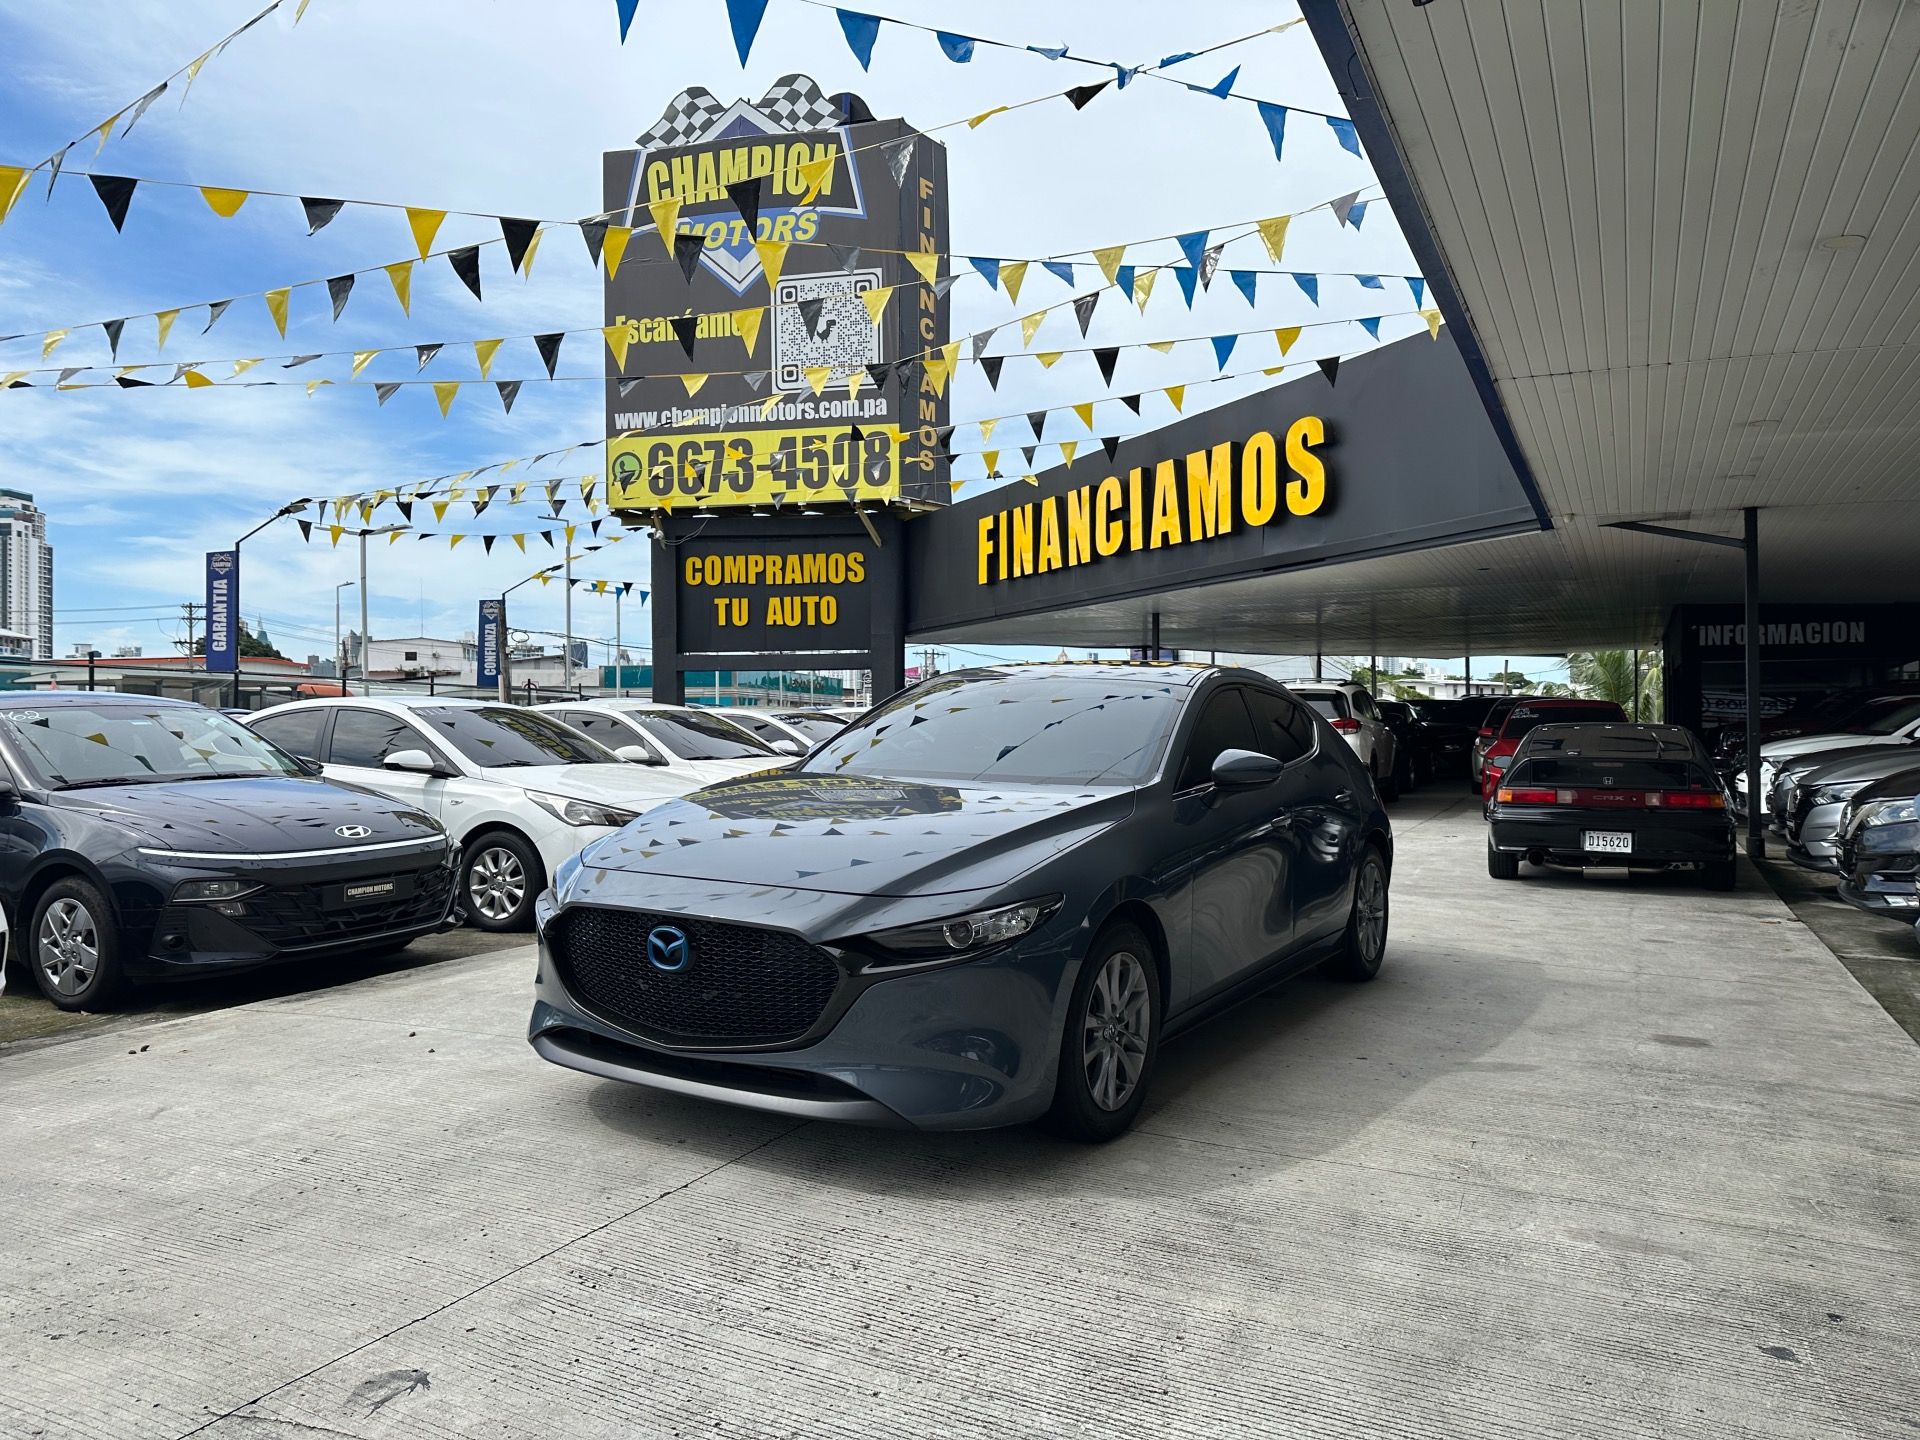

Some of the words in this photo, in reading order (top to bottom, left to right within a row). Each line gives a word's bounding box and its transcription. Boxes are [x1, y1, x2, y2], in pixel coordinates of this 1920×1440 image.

[647, 143, 836, 206] CHAMPION
[615, 308, 743, 345] scanam
[919, 176, 937, 471] FINNCIAMOS
[615, 398, 887, 430] www.championmotors.com.pa
[648, 431, 891, 496] 6673-4508
[978, 416, 1326, 585] FINANCIAMOS
[685, 552, 865, 586] COMPRAMOS
[212, 578, 228, 652] GARANTIA
[714, 597, 749, 627] TU
[766, 595, 838, 626] AUTO
[484, 622, 497, 676] CONFIANZA
